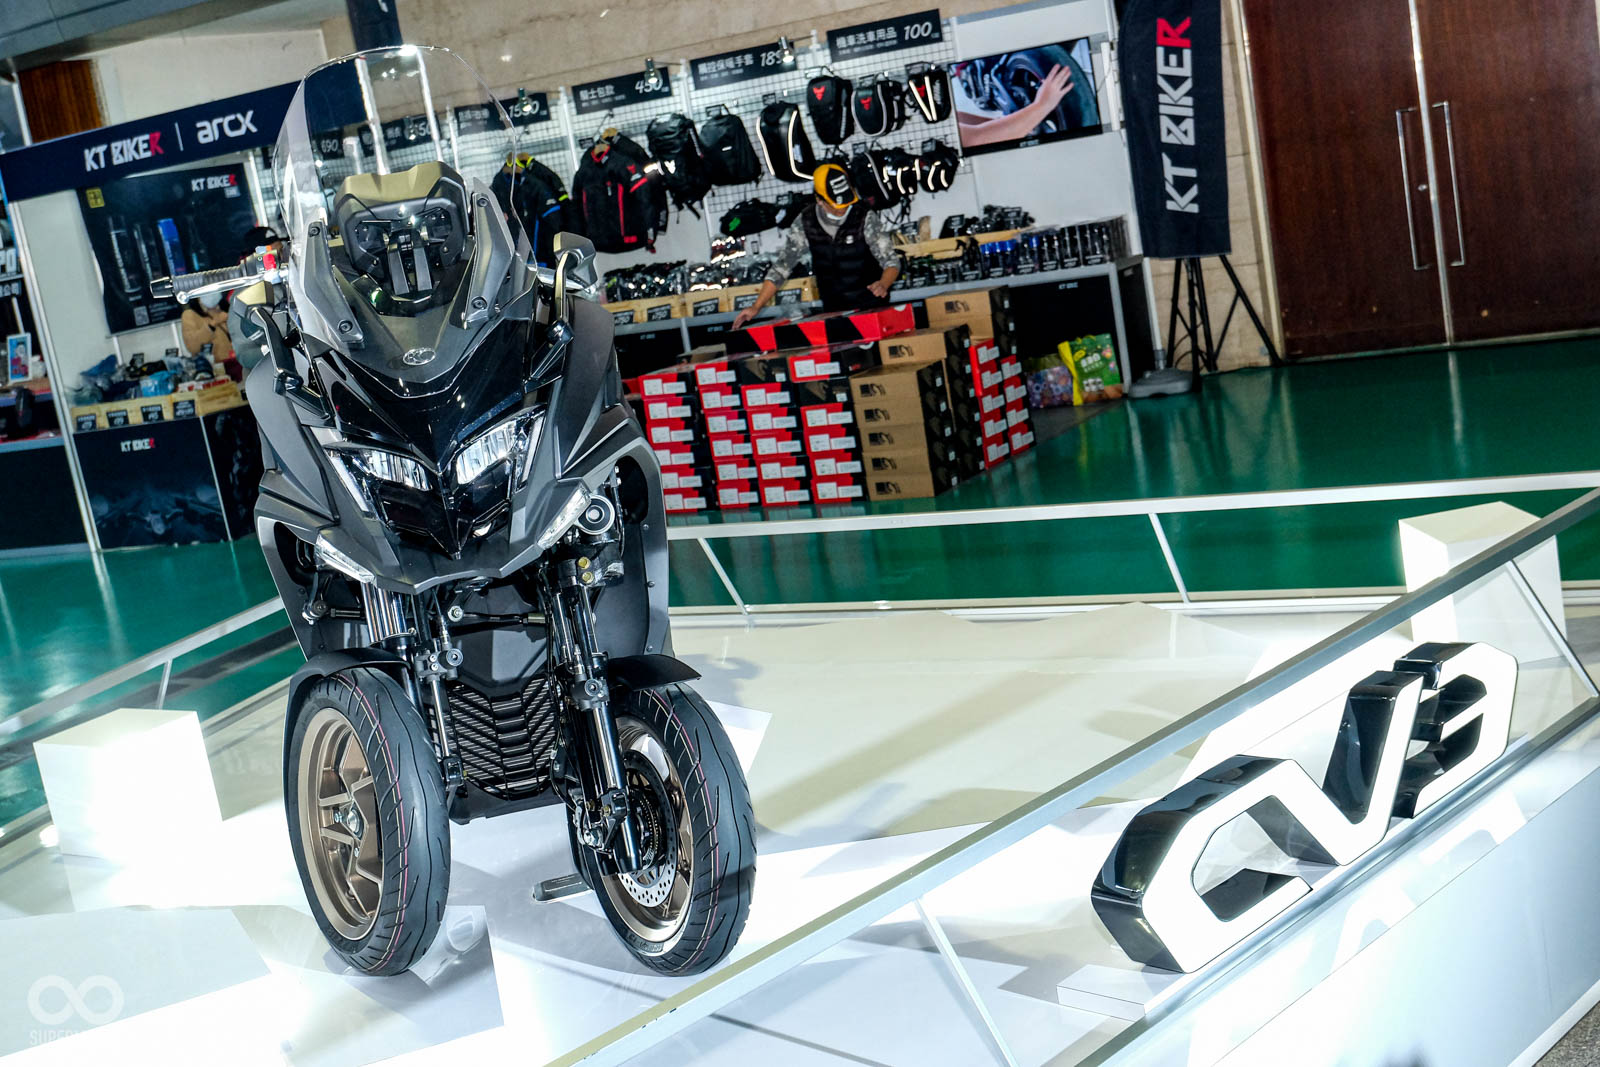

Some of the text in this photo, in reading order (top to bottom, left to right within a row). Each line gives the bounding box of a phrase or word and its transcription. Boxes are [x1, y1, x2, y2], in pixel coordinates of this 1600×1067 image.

[903, 20, 934, 41] 100
[1156, 16, 1199, 213] KT BIKER
[84, 131, 165, 172] KT BIKER
[191, 177, 206, 192] KT
